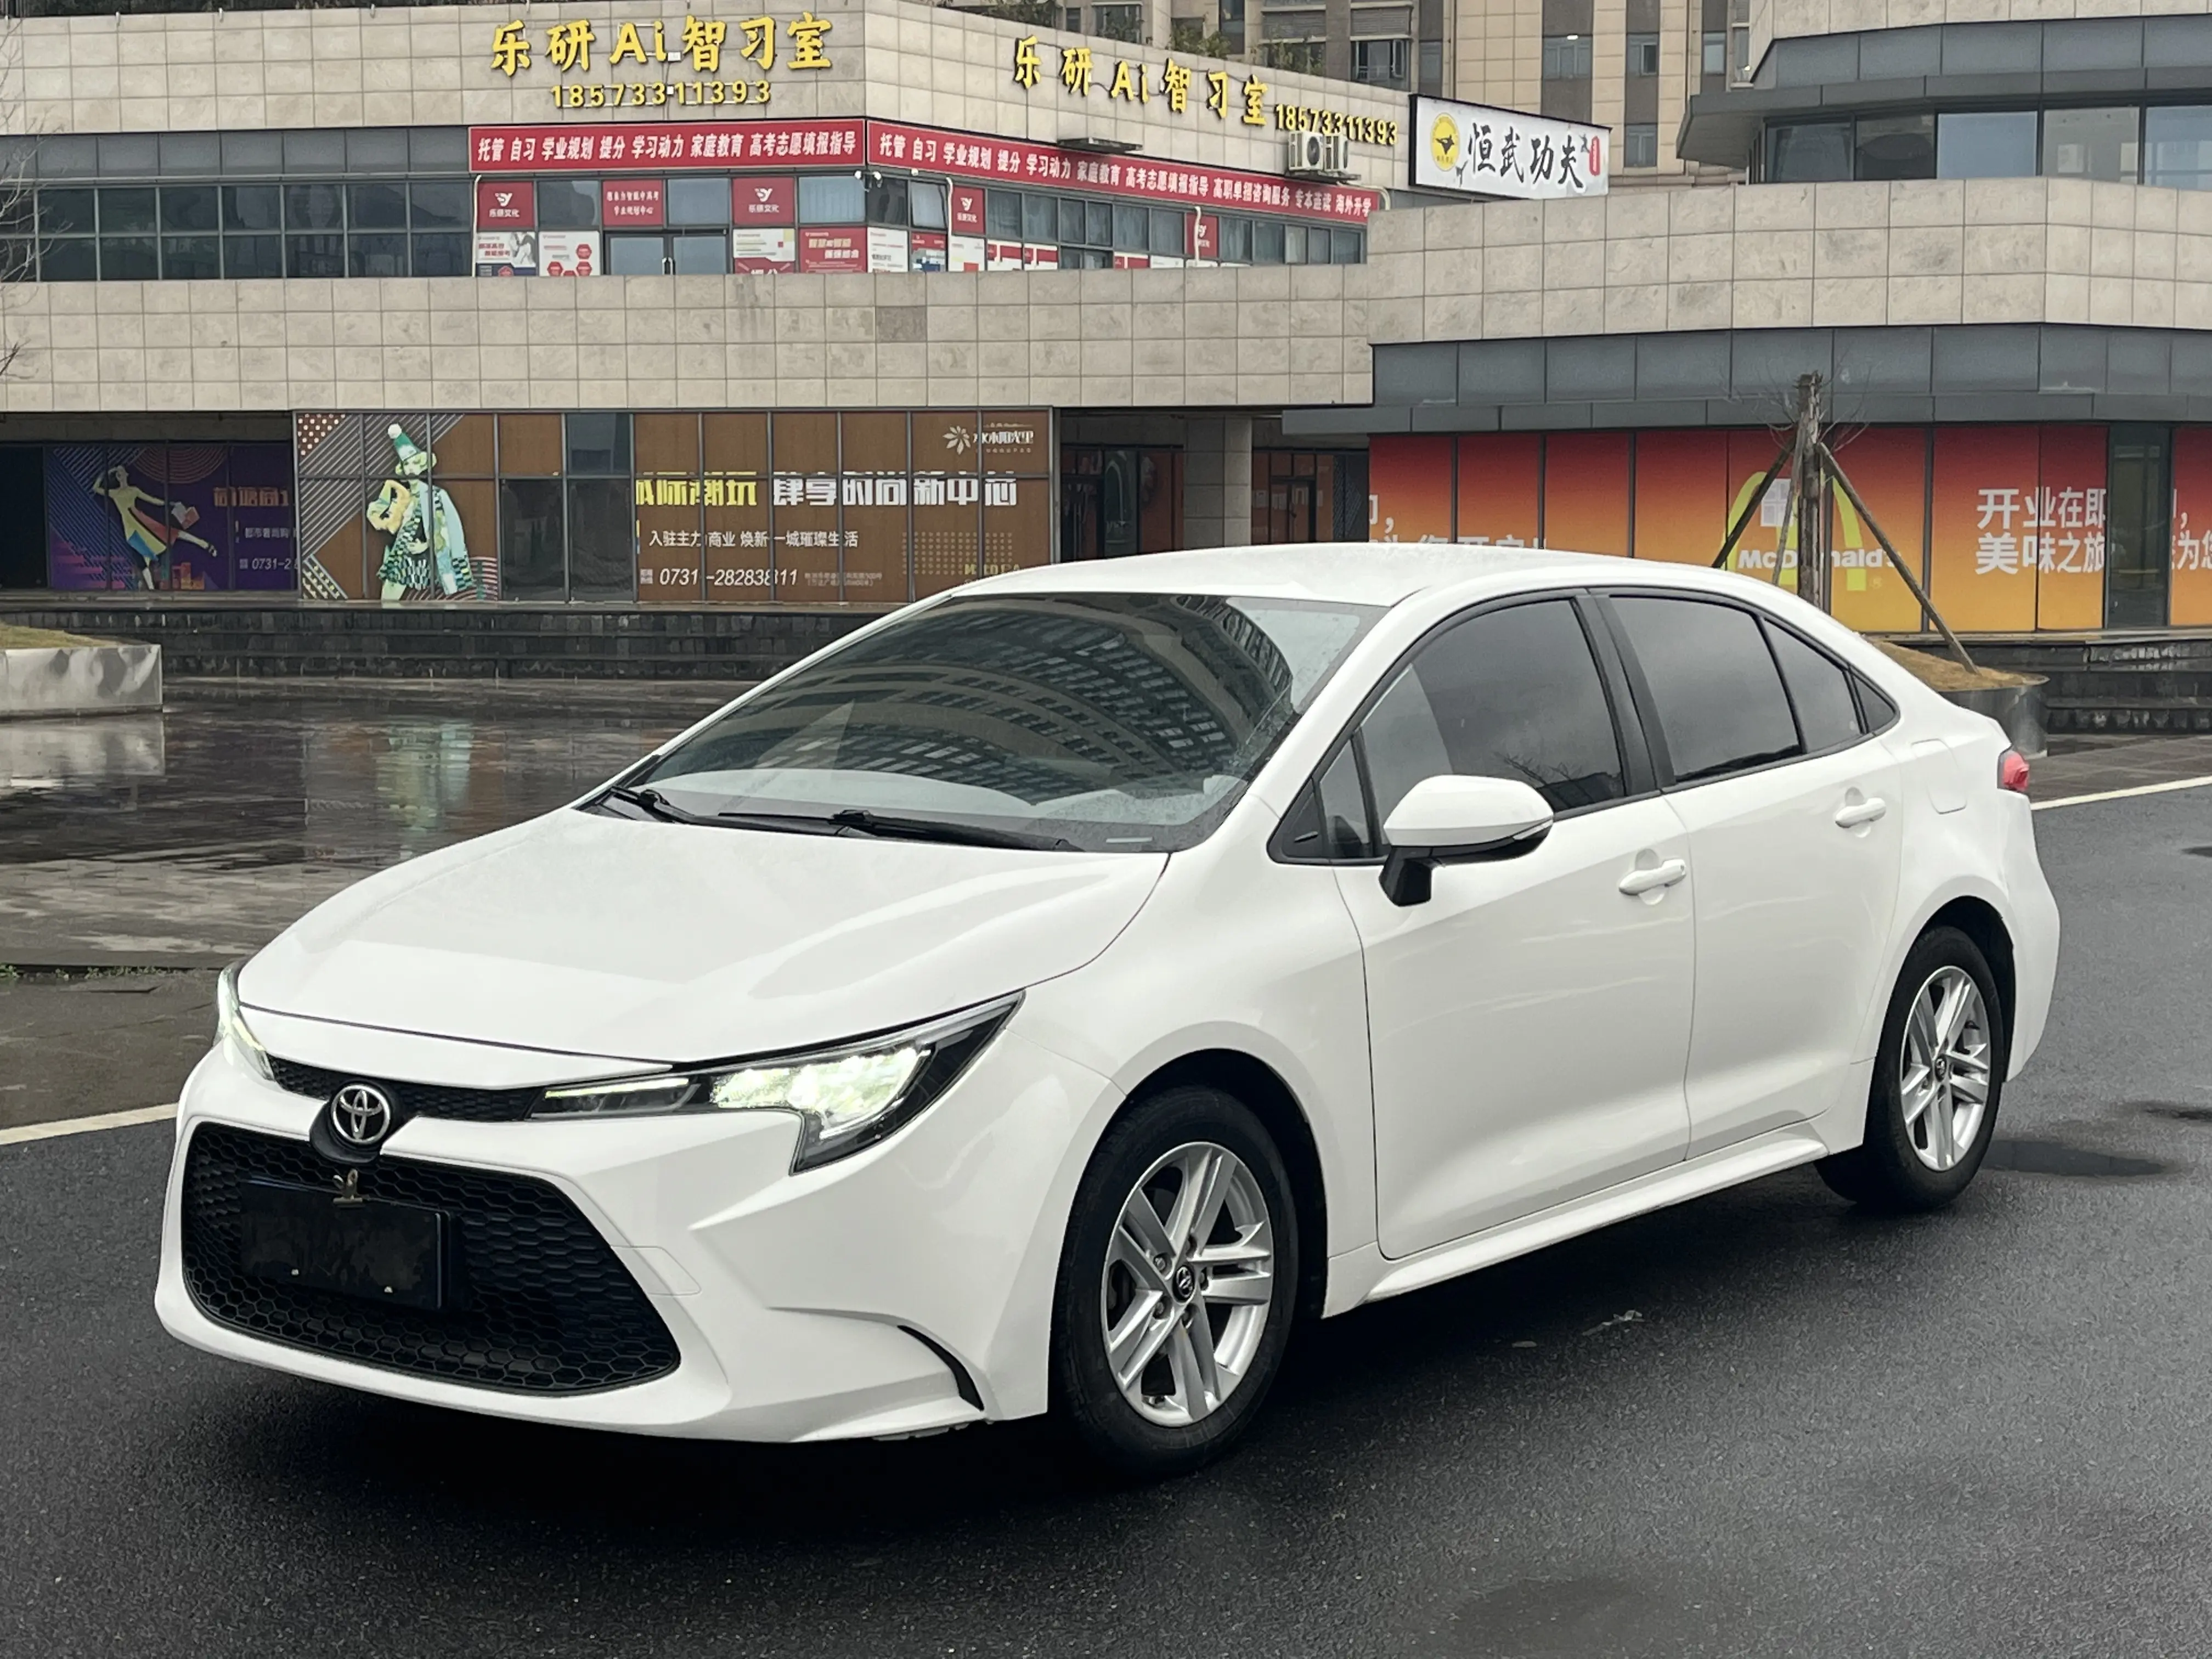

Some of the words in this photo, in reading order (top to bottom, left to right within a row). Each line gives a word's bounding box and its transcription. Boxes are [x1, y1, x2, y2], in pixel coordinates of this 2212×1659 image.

[551, 81, 771, 107] 18573311393
[1276, 104, 1397, 145] 18573311393
[478, 138, 505, 162] 托管
[510, 137, 536, 161] 自习
[541, 136, 594, 161] 学业规划
[599, 136, 625, 159] 提分
[631, 134, 684, 159] 学习动力
[690, 133, 744, 157] 家庭教育
[749, 131, 856, 157] 高考志愿填报指导
[879, 133, 906, 159] 托管
[912, 137, 937, 162] 自习
[943, 142, 992, 171] 学业规划
[997, 149, 1021, 173] 提分
[1026, 153, 1071, 179] 学习动力
[1077, 161, 1121, 187] 家庭教育
[1125, 166, 1209, 197] 高考志愿填报指导
[1468, 122, 1584, 188] 恒武功夫
[1976, 486, 2107, 530] 开业在即
[649, 530, 736, 548] 入驻主力商业
[1975, 532, 2106, 574] 美味之旅
